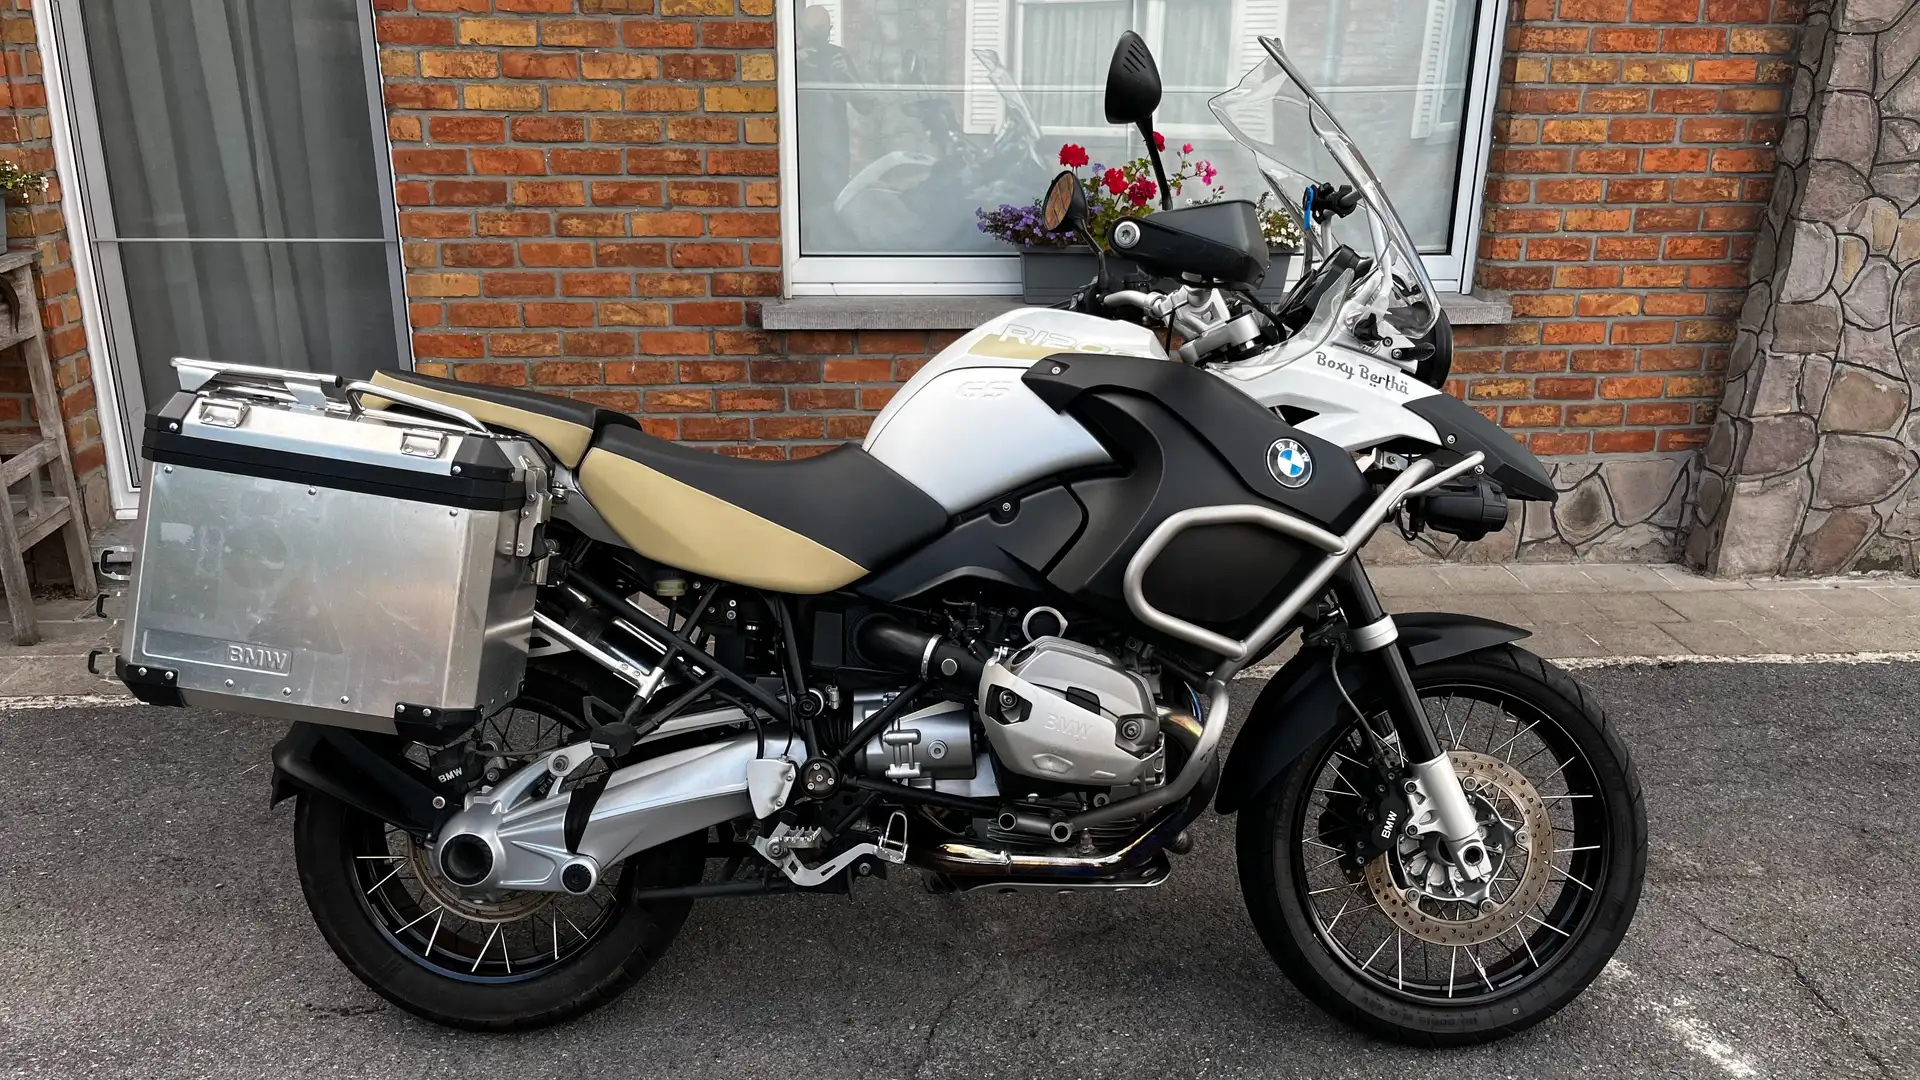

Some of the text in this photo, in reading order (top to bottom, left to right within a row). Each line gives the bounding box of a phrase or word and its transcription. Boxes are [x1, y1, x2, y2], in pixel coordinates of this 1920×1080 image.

[1316, 352, 1355, 380] Boxy
[955, 381, 1014, 400] GS
[1275, 441, 1310, 462] BMW
[228, 645, 287, 670] BMW
[1044, 712, 1095, 740] BMW
[438, 767, 463, 783] BMW
[1381, 810, 1398, 839] BMW
